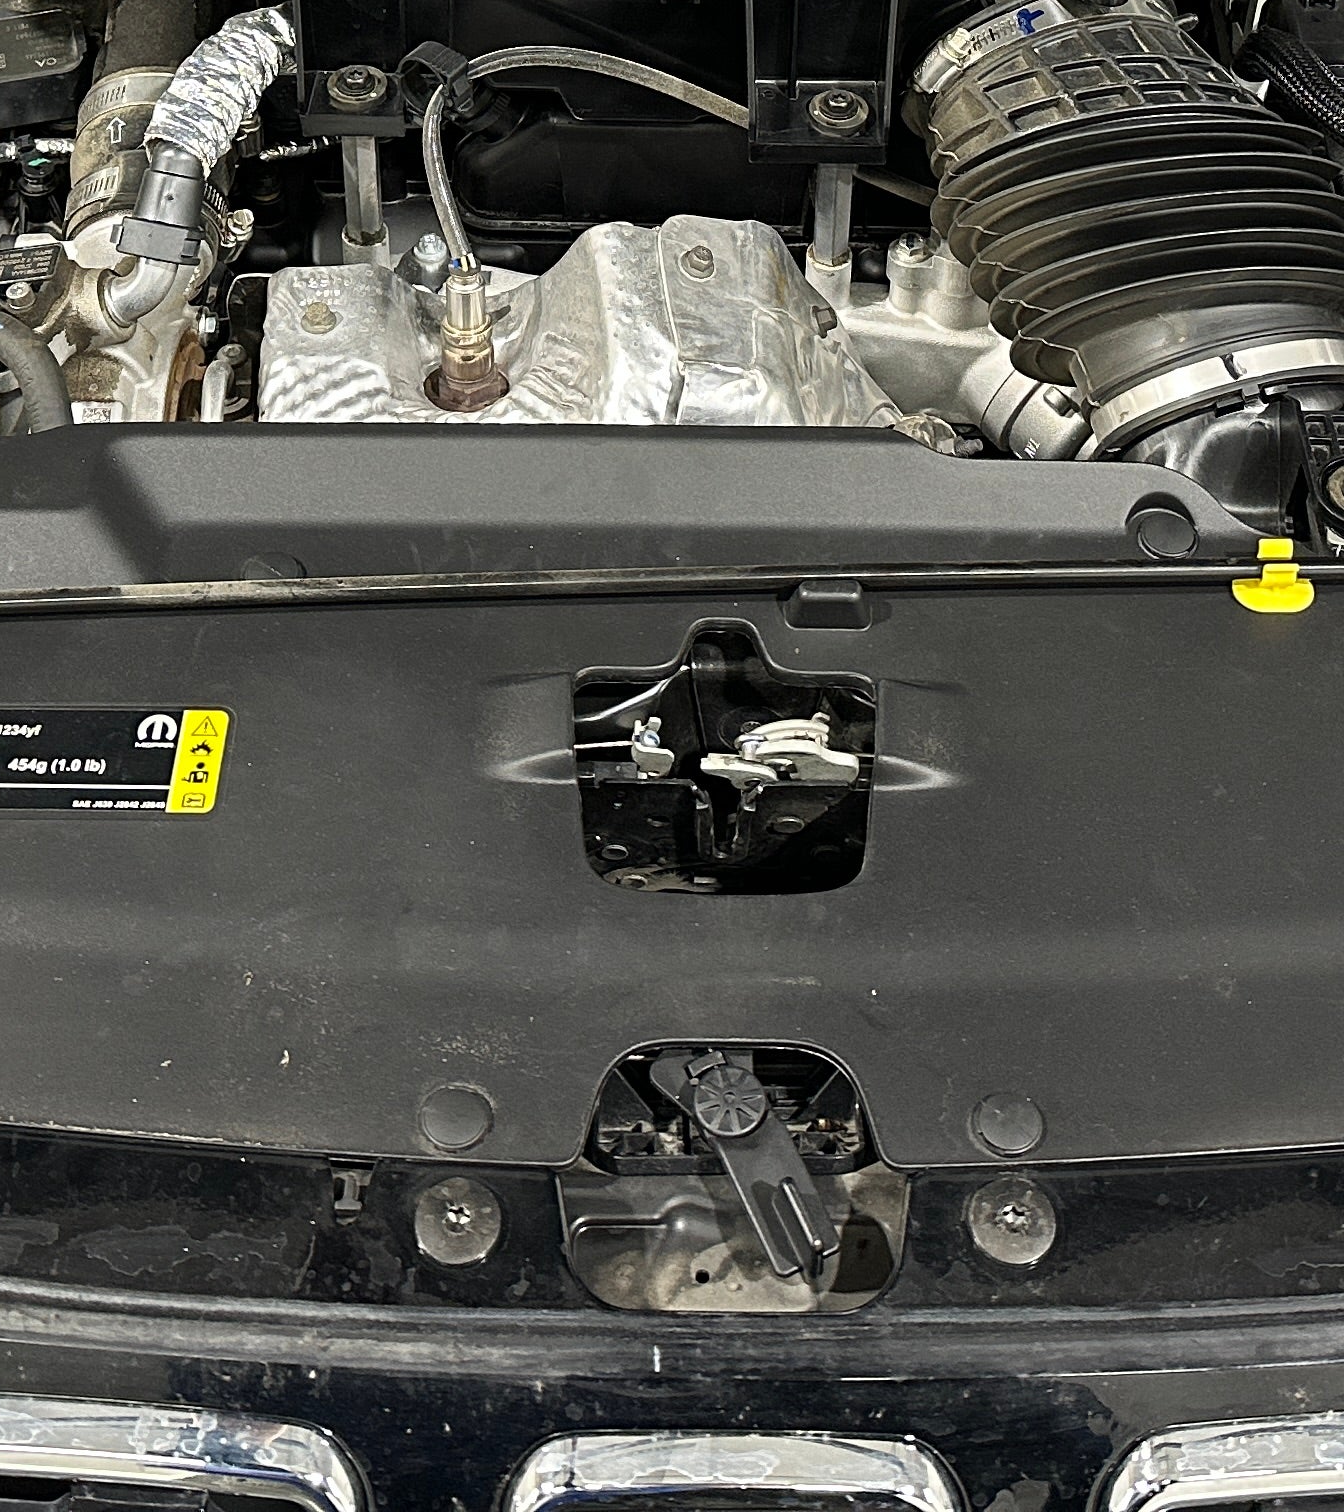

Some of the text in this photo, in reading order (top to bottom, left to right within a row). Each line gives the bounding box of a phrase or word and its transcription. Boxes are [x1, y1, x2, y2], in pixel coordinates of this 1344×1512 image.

[7, 758, 107, 775] 454g (1.0 lb)
